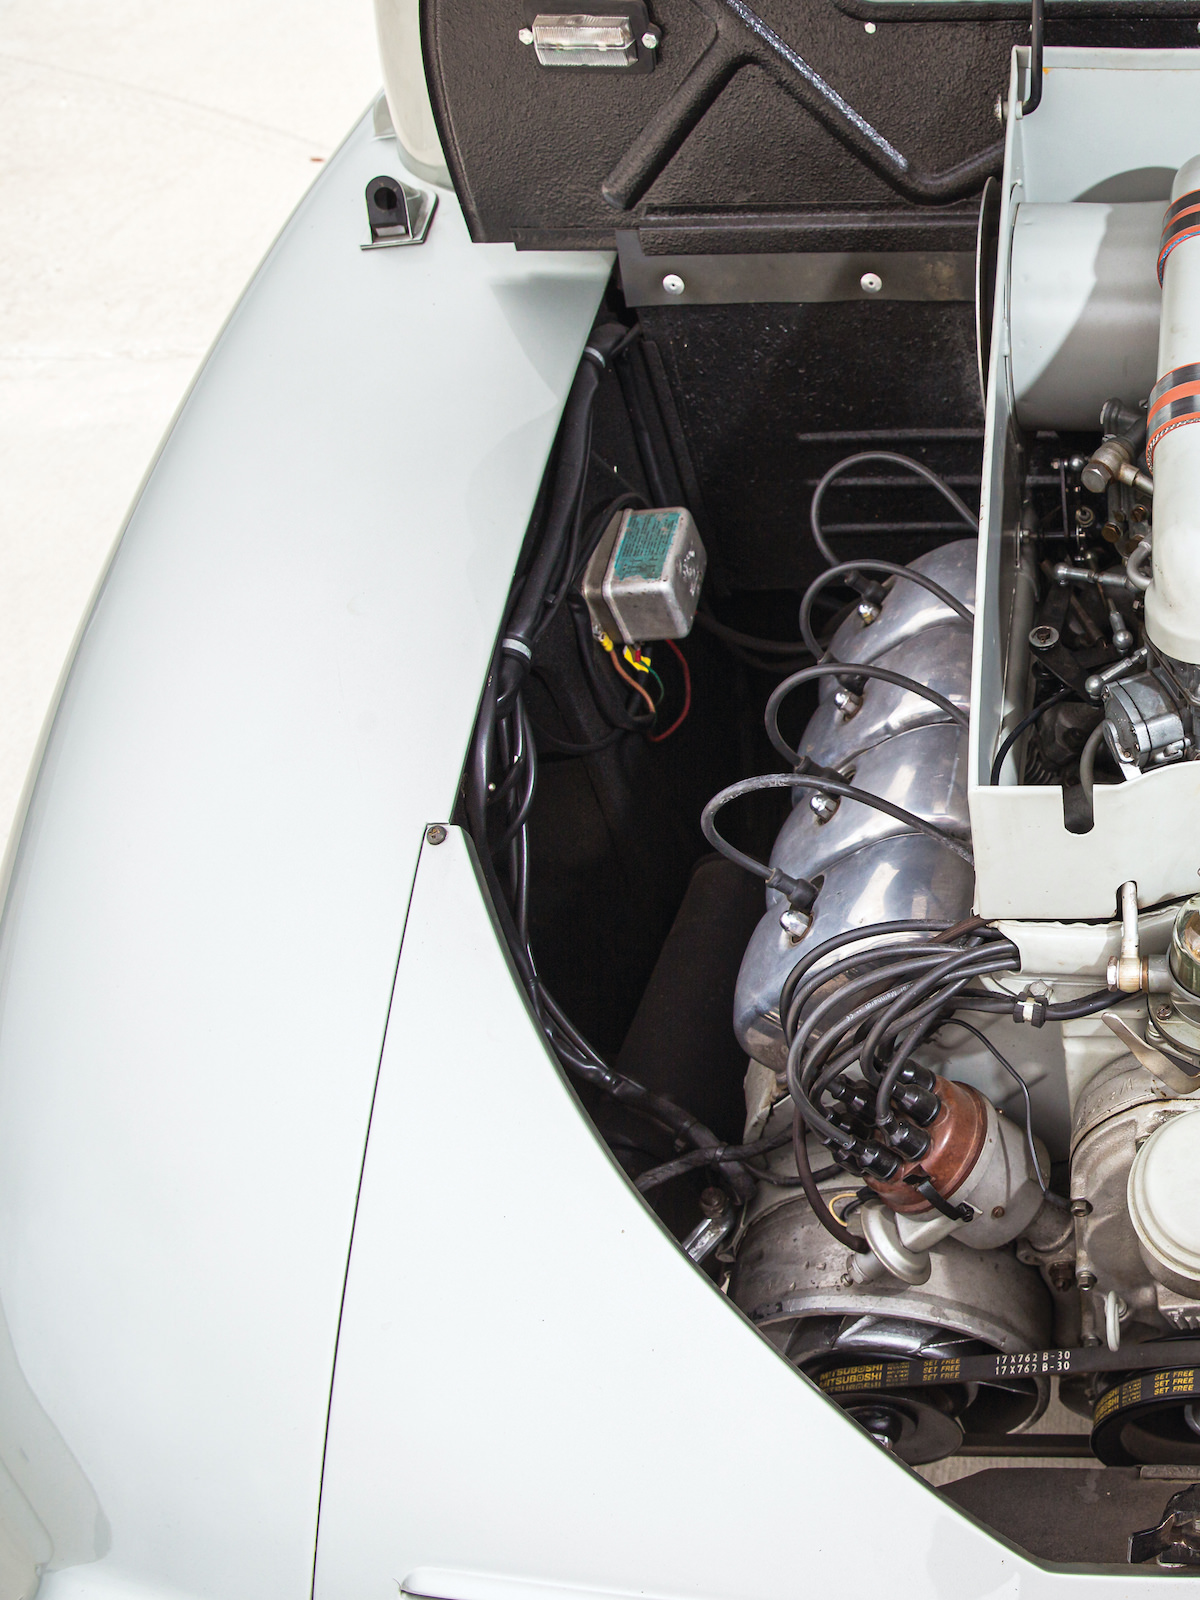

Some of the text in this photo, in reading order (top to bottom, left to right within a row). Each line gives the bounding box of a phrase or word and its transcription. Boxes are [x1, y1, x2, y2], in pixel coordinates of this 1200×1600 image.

[1042, 1351, 1070, 1361] B-30
[922, 1366, 938, 1374] SET
[1042, 1361, 1070, 1372] B-30
[922, 1372, 961, 1382] SET FREE
[1154, 1370, 1195, 1381] SET FREE
[1154, 1377, 1194, 1389] SET FREE
[1153, 1384, 1194, 1396] SET FREE
